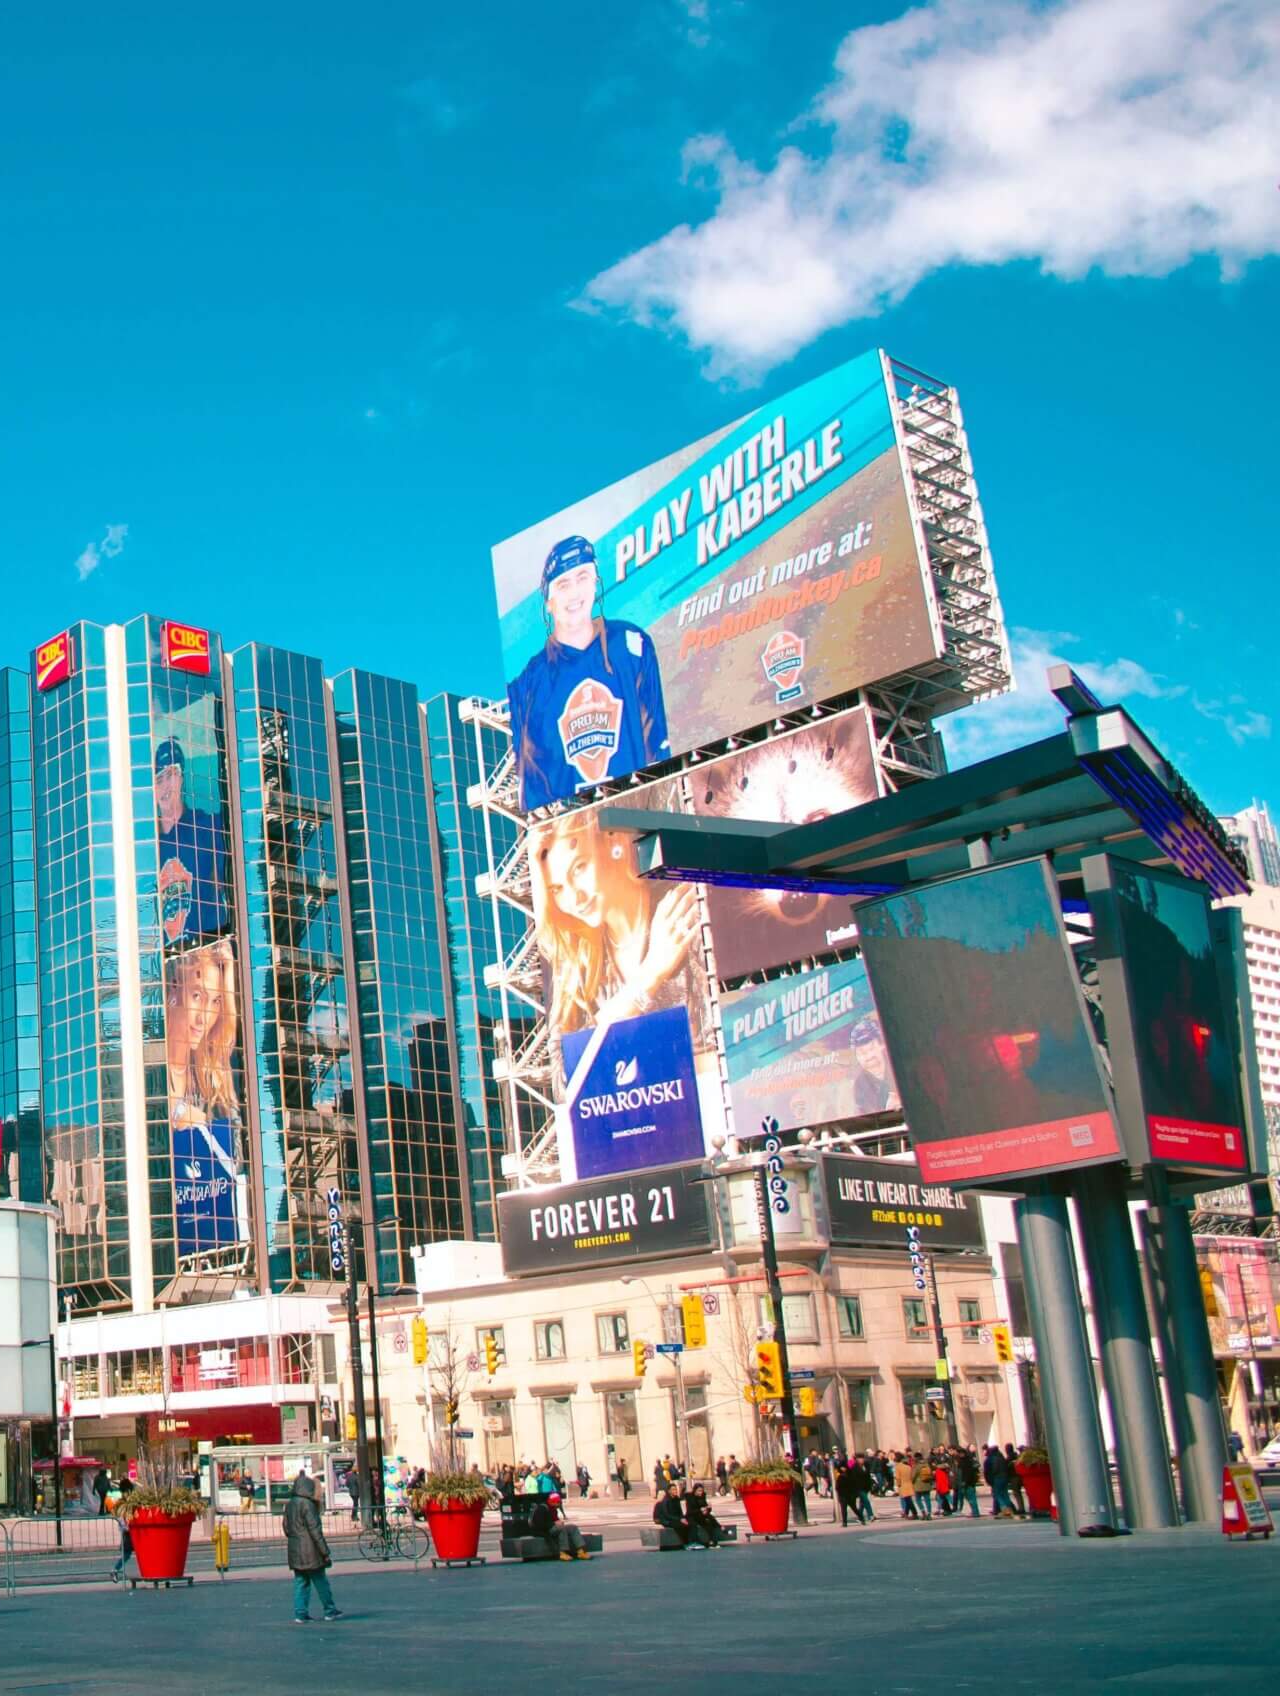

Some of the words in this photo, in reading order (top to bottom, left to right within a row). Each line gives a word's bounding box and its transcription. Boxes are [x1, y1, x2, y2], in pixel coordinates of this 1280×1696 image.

[616, 488, 692, 582] PLAY
[699, 415, 785, 516] WITH
[697, 419, 843, 566] KABERLE
[678, 583, 723, 626] Find
[728, 565, 767, 602] out
[771, 540, 832, 586] more
[837, 522, 873, 557] at:
[679, 555, 882, 660] ProAmHockey.ca
[38, 638, 65, 666] CIBC
[170, 627, 207, 650] CIBC
[732, 999, 777, 1043] PLAY
[781, 972, 830, 1018] WITH
[783, 986, 854, 1041] TUCKER
[793, 1055, 823, 1071] more
[580, 1079, 685, 1119] SWAROVSKI
[530, 1193, 639, 1241] FOREVER
[648, 1186, 676, 1223] 21
[838, 1178, 864, 1201] LIKE
[877, 1181, 908, 1206] WEAR
[921, 1187, 954, 1208] SHARE
[574, 1232, 631, 1248] FOREVER21.COM
